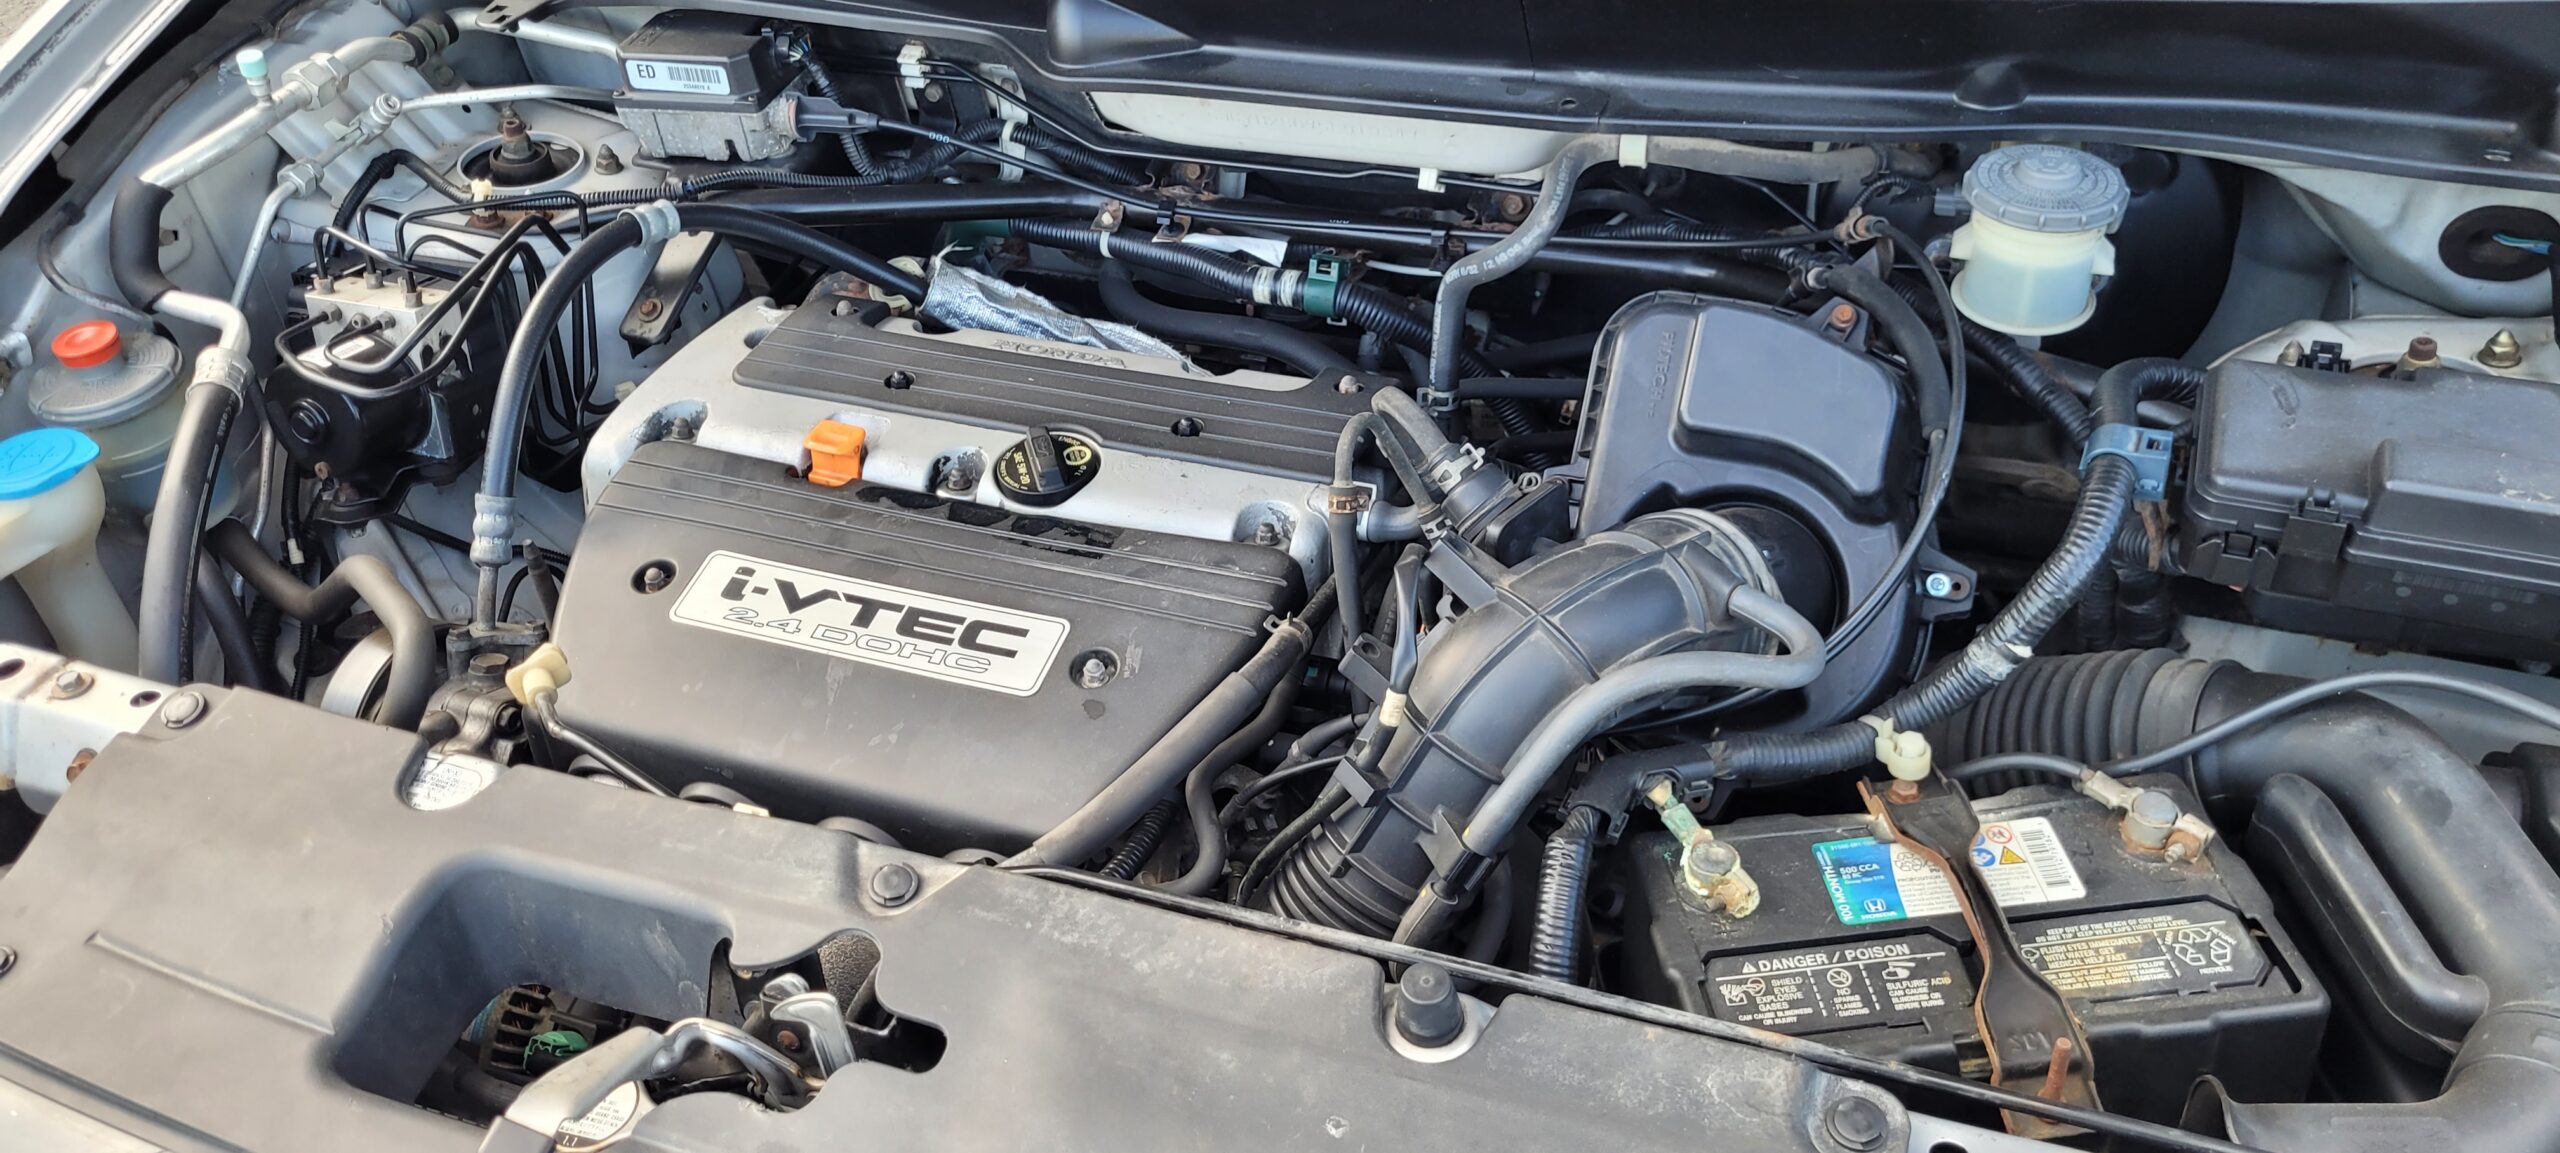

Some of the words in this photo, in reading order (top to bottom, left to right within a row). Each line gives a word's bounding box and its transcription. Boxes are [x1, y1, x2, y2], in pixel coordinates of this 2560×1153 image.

[636, 63, 656, 79] ED
[720, 566, 1031, 660] i-VTEC
[722, 606, 802, 636] 2.4
[810, 623, 992, 675] DOHC
[1840, 865, 1858, 875] 500
[1858, 863, 1881, 872] CCA
[1822, 866, 1847, 903] MONTH
[1838, 904, 1854, 921] 100
[1860, 911, 1897, 920] HONDA
[2065, 925, 2079, 933] OUT
[2104, 920, 2127, 928] REACH
[2094, 928, 2112, 936] VENT
[2113, 925, 2132, 933] CAPS
[2039, 944, 2067, 955] FLUSH
[2066, 941, 2089, 951] EYES
[2088, 935, 2143, 949] IMMEDIATELY
[1758, 952, 1829, 972] DANGER
[1844, 943, 1911, 961] POISON
[2043, 952, 2067, 962] WITH
[2099, 947, 2115, 955] GET
[2047, 958, 2085, 969] MEDICAL
[2083, 955, 2105, 965] HELP
[2105, 952, 2127, 962] FAST
[2138, 960, 2165, 969] FOLLOW
[2199, 965, 2233, 975] RECYCLE
[1771, 976, 1803, 986] SHIELD
[1886, 978, 1929, 990] SULFURIC
[1930, 976, 1952, 986] ACID
[1774, 985, 1798, 995] EYES
[1836, 988, 1851, 996] NO
[1889, 989, 1905, 997] CAN
[1905, 986, 1929, 995] CAUSE
[1756, 991, 1804, 1004] EXPLOSIVE
[1891, 993, 1930, 1004] BLINDNESS
[1930, 991, 1942, 999] OR
[1759, 1001, 1790, 1012] GASES
[1836, 1001, 1863, 1010] FLAMES
[1894, 1001, 1921, 1011] SEVERE
[1920, 999, 1945, 1008] BURNS
[1754, 1011, 1776, 1020] CAUSE
[1776, 1007, 1813, 1017] BLINDNESS
[1839, 1007, 1870, 1017] SMOKING
